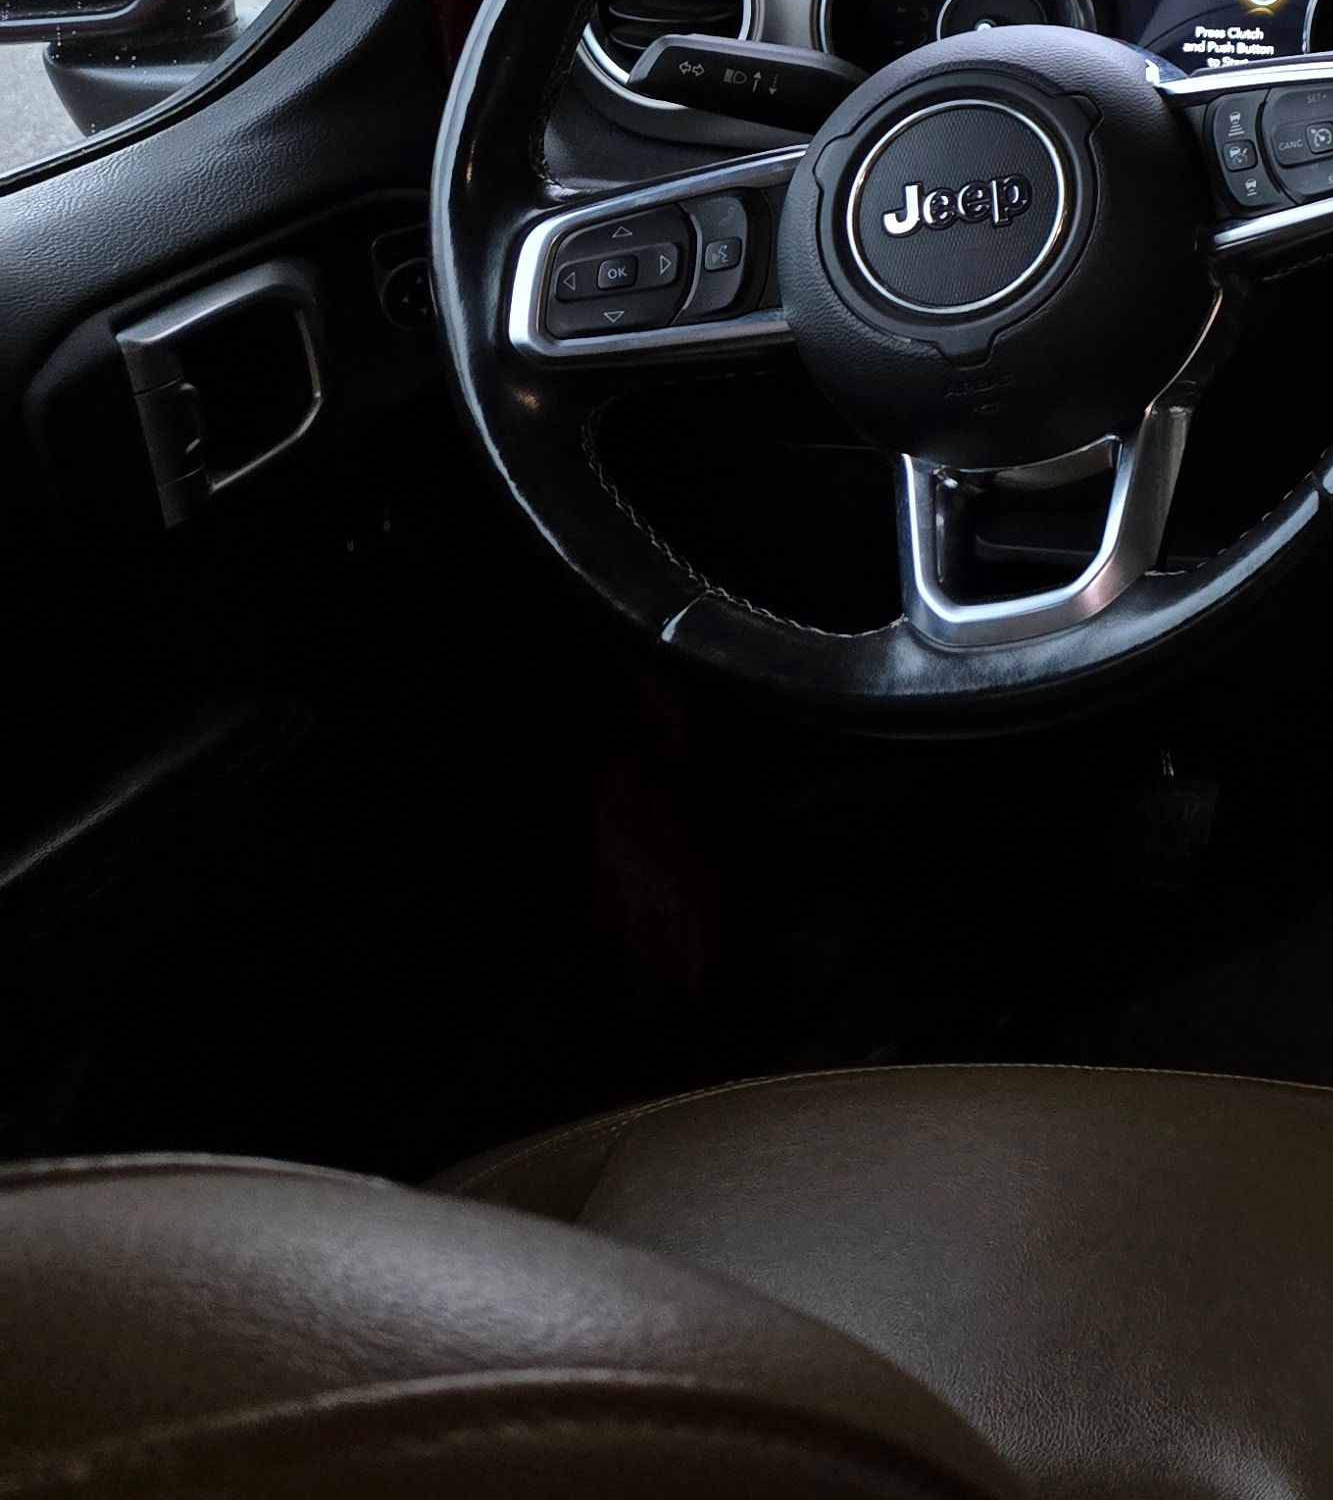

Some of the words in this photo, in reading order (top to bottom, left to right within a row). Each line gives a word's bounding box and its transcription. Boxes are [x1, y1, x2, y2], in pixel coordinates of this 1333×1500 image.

[1195, 26, 1226, 39] Press
[1227, 27, 1265, 40] Clutch
[1182, 41, 1206, 53] and
[1207, 41, 1236, 54] Push
[1236, 43, 1275, 55] Button
[1207, 58, 1221, 68] to
[882, 175, 1033, 238] Jeep
[607, 267, 629, 280] OK
